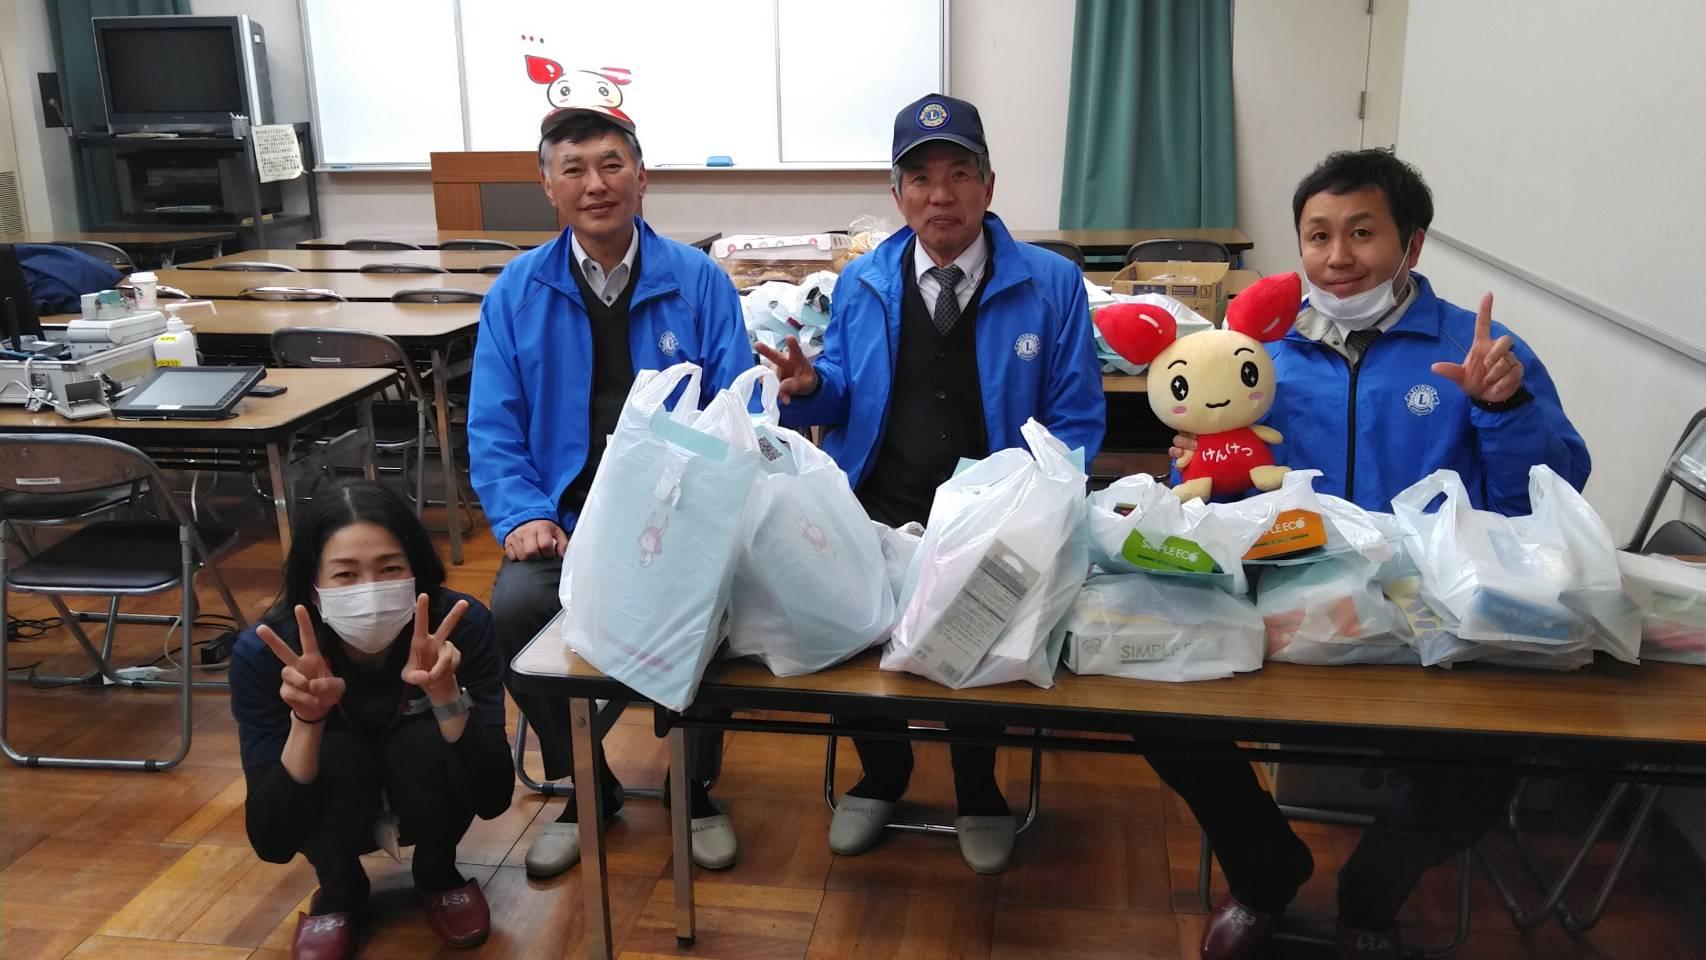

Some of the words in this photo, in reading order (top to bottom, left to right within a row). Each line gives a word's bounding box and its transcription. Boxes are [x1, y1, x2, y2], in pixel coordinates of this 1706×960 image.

[930, 111, 938, 119] L
[1026, 342, 1032, 351] L
[1419, 394, 1427, 404] L
